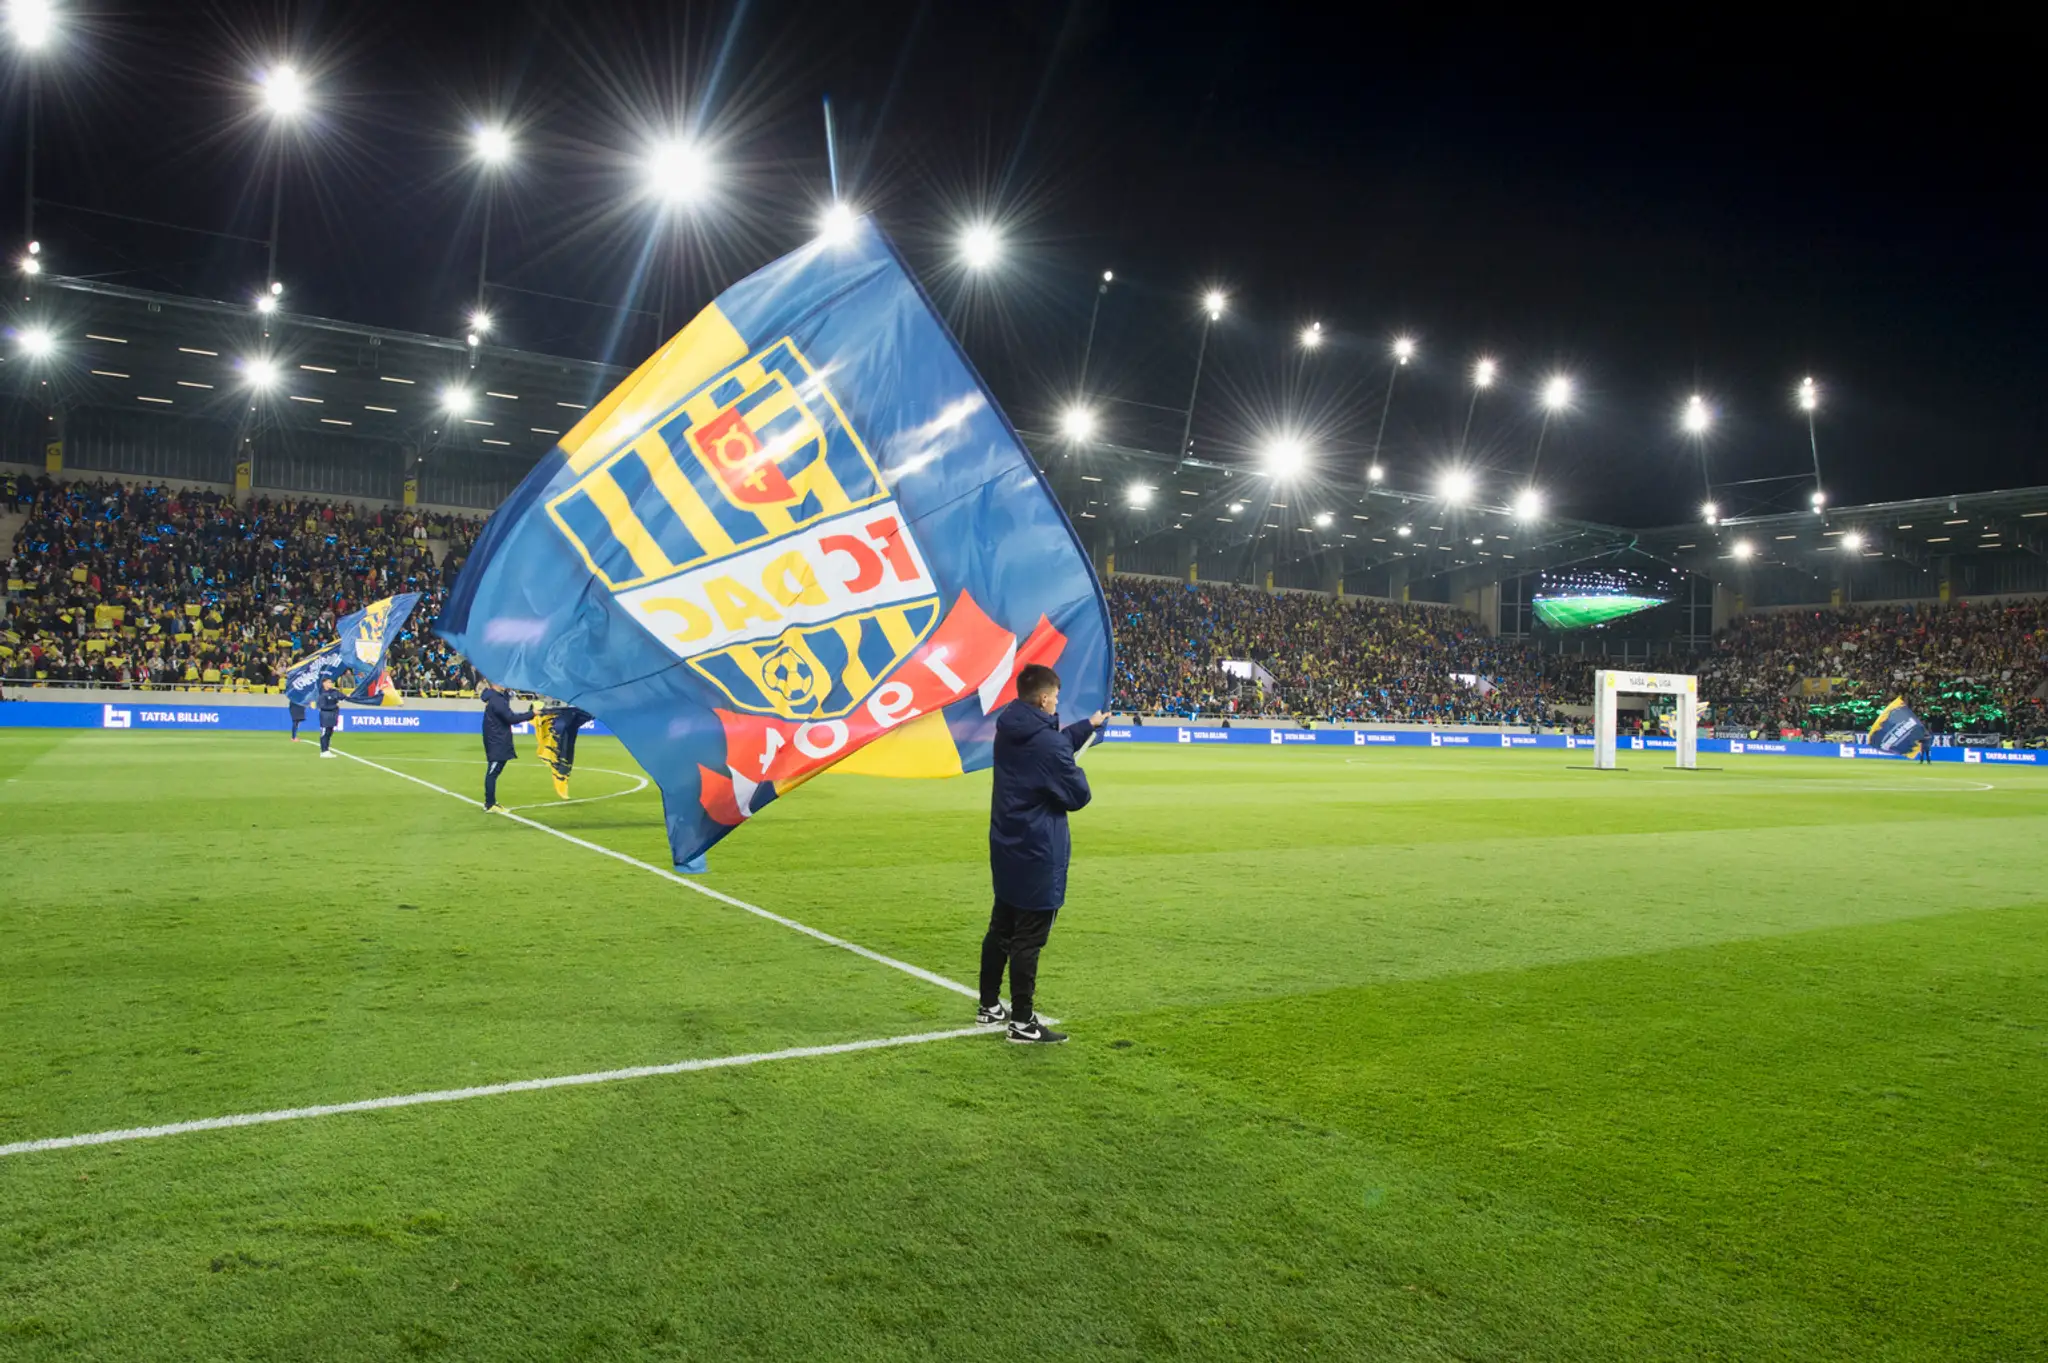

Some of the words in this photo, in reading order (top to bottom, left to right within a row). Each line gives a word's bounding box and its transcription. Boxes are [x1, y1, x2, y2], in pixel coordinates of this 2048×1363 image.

[140, 711, 175, 722] TATRA
[177, 712, 219, 723] BILLING
[352, 716, 382, 726] TATRA
[383, 716, 420, 727] BILLING
